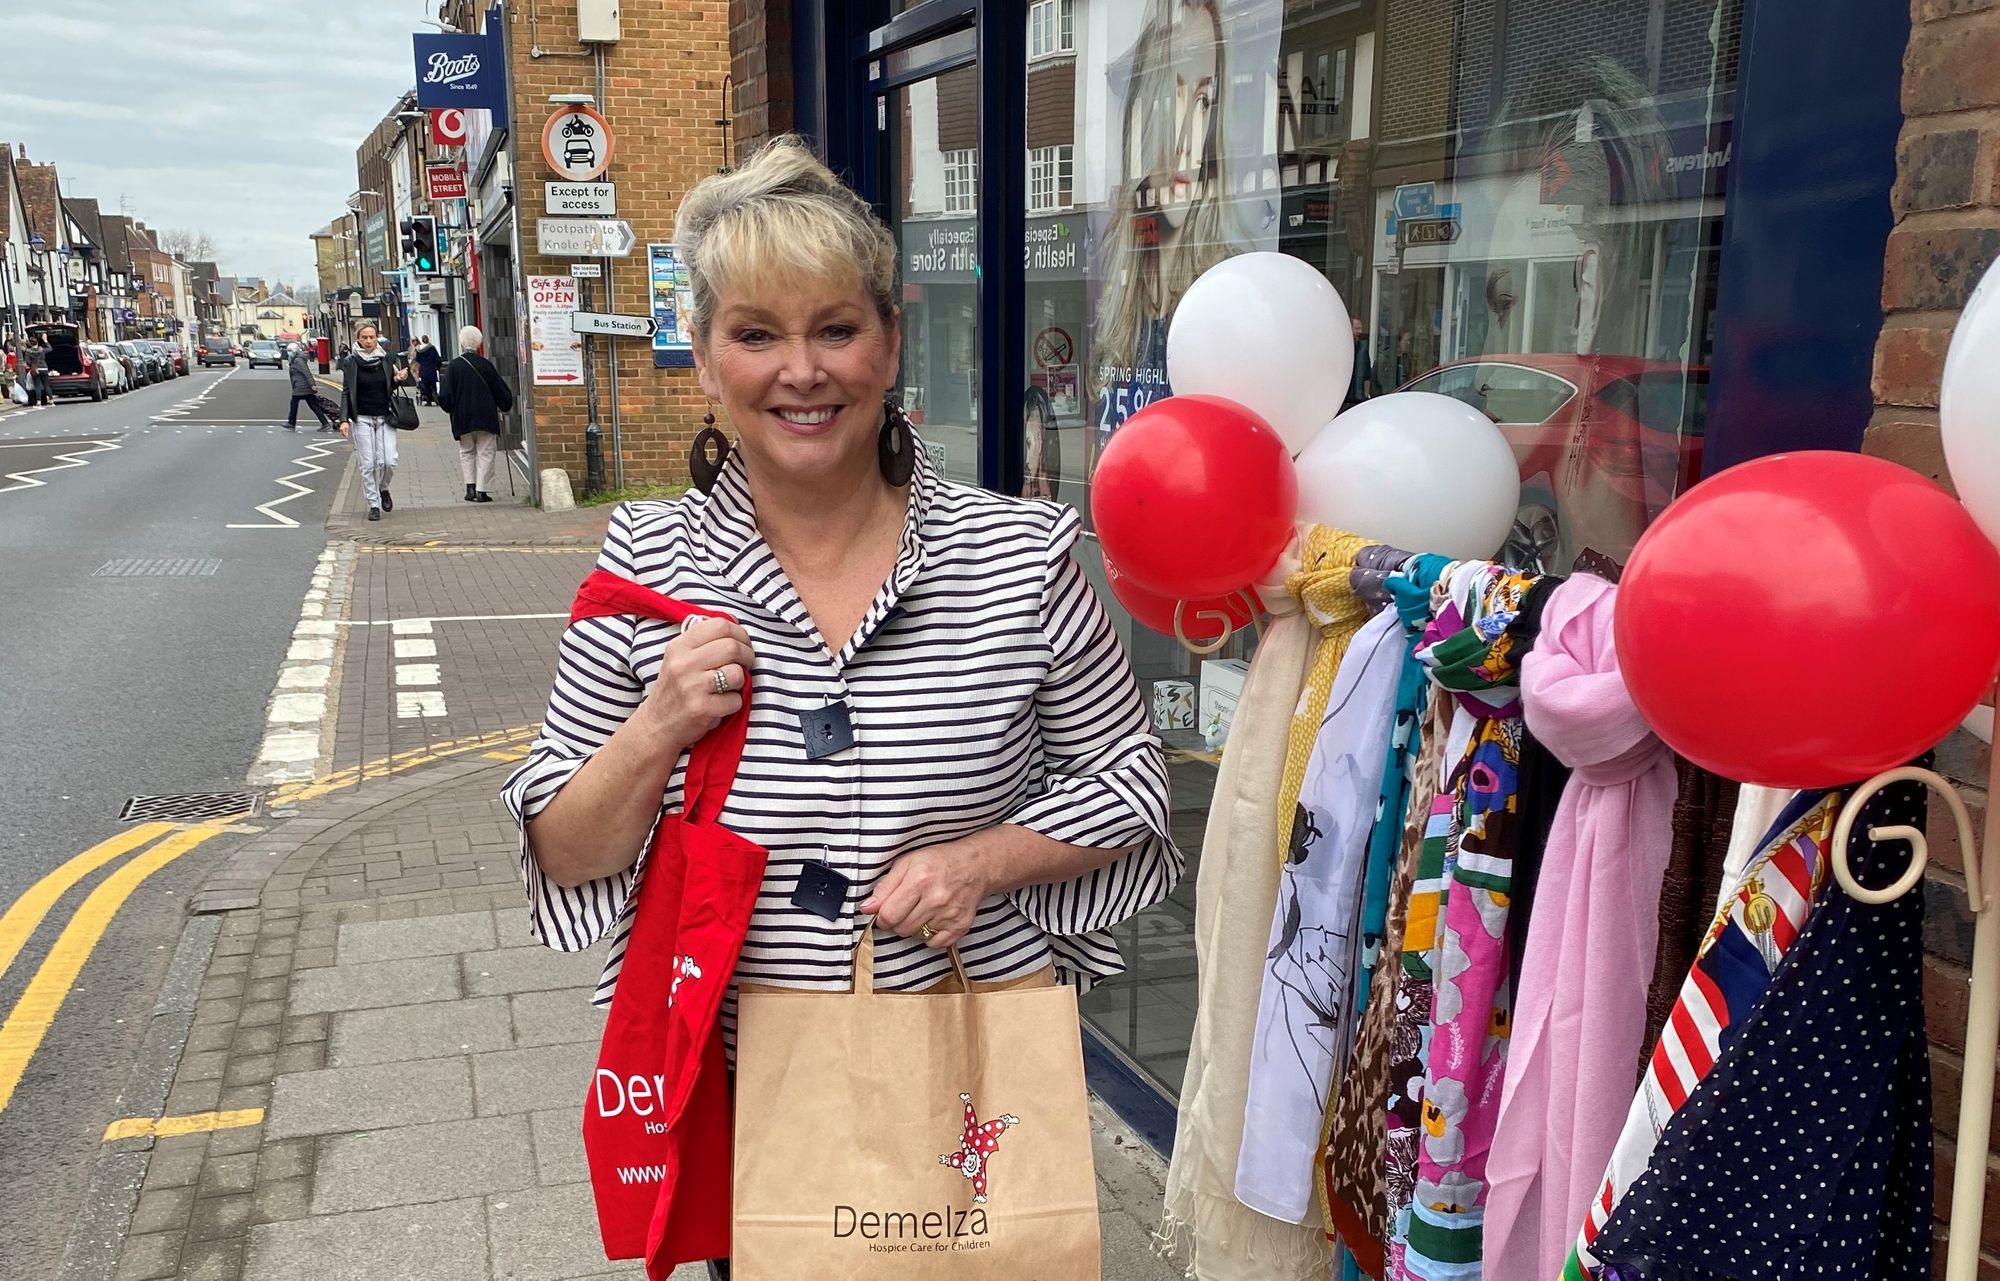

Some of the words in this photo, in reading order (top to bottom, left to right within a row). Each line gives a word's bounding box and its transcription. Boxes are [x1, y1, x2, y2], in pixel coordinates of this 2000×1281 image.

[423, 52, 480, 84] Boots
[431, 174, 462, 182] MOBILE
[433, 184, 463, 193] STREET
[551, 186, 590, 198] Except
[593, 186, 609, 197] for
[561, 201, 600, 209] access
[542, 223, 597, 236] Footpath
[602, 224, 615, 234] to
[544, 240, 579, 250] Knole
[584, 240, 612, 250] Pak
[534, 292, 574, 302] OPEN
[594, 319, 609, 328] Bus
[611, 320, 642, 331] Station
[1099, 366, 1131, 383] SPRING
[1135, 367, 1169, 385] HIGHLI
[833, 1204, 989, 1239] Demelza
[869, 1243, 907, 1254] Hospice
[910, 1243, 932, 1252] Care
[935, 1242, 949, 1252] for
[951, 1239, 991, 1251] Children
